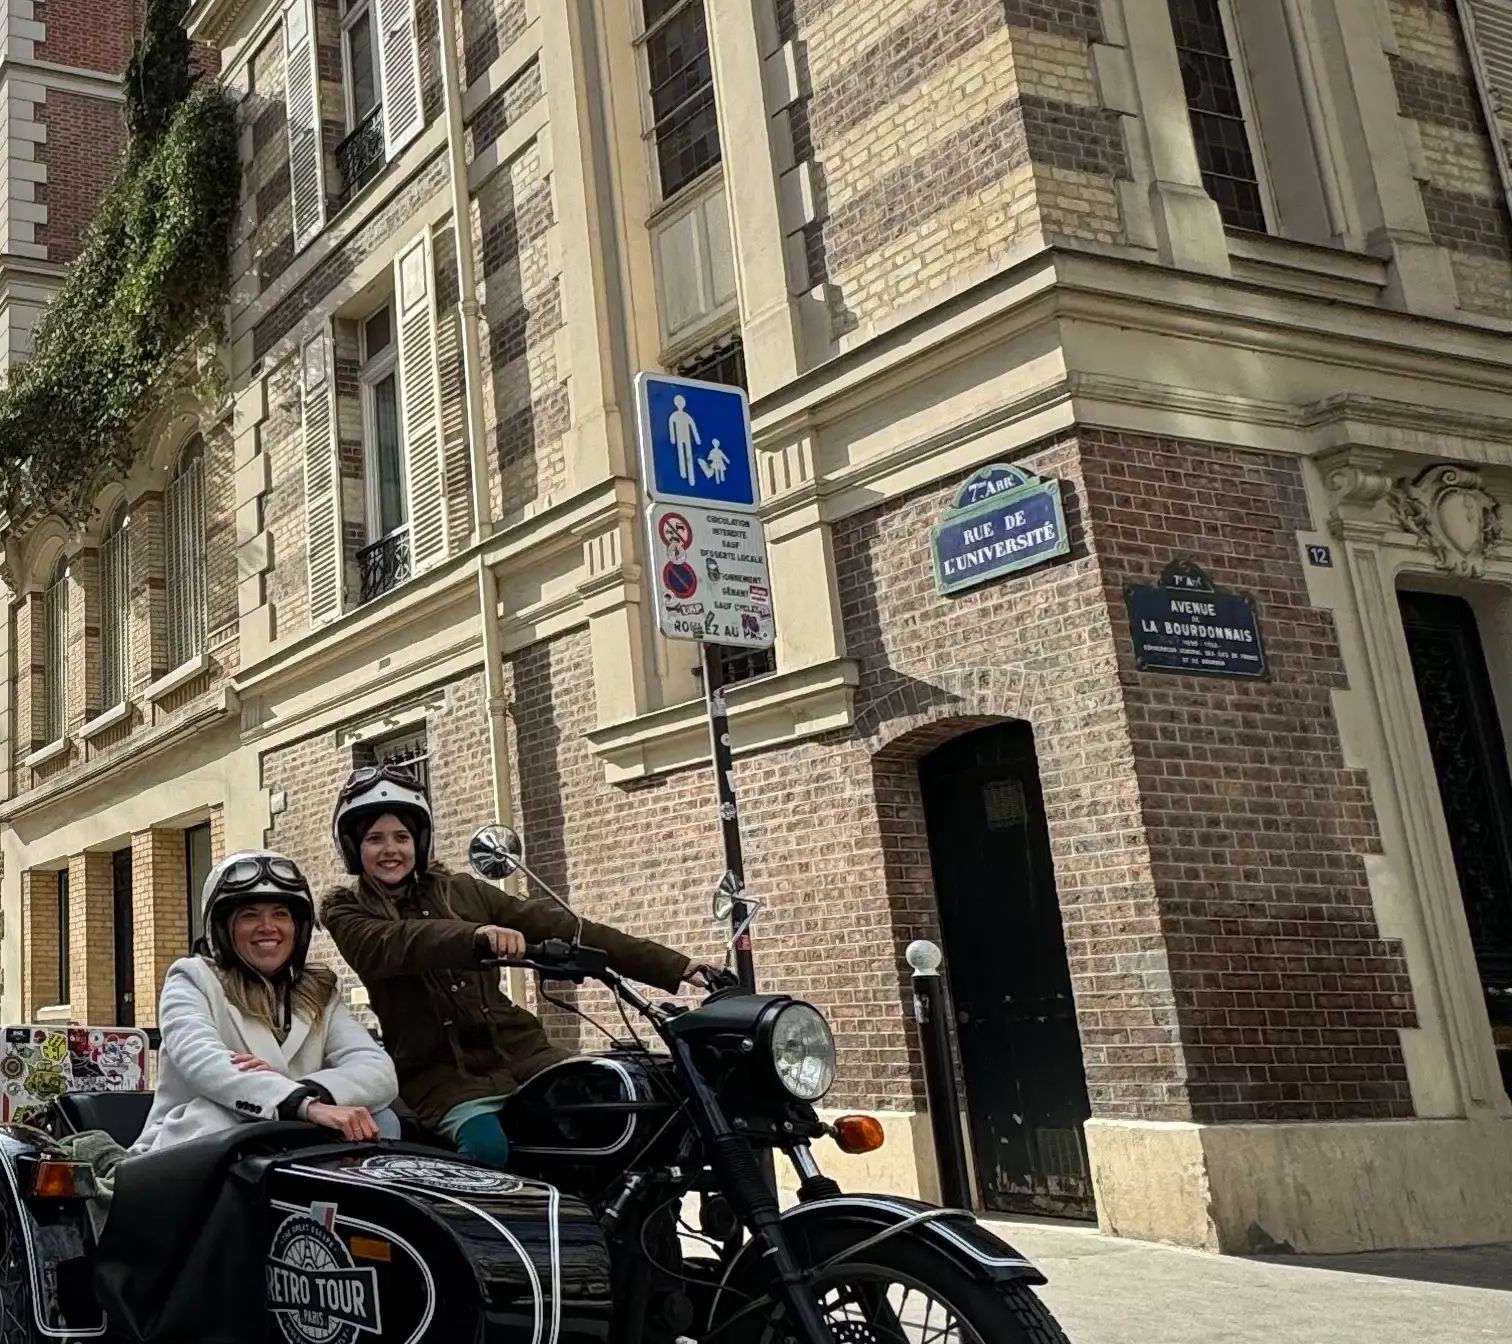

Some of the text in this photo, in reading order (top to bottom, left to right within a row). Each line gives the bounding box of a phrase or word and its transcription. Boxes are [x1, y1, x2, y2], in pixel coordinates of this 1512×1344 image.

[963, 510, 1026, 545] RUE DE
[943, 520, 1056, 576] L'UNIVERSITÉ
[1310, 548, 1329, 564] 12
[1170, 599, 1217, 617] AVENUE
[724, 625, 740, 638] AU
[1141, 619, 1253, 643] LA BOURDONNAIS
[266, 1265, 368, 1318] RETRO TOUR
